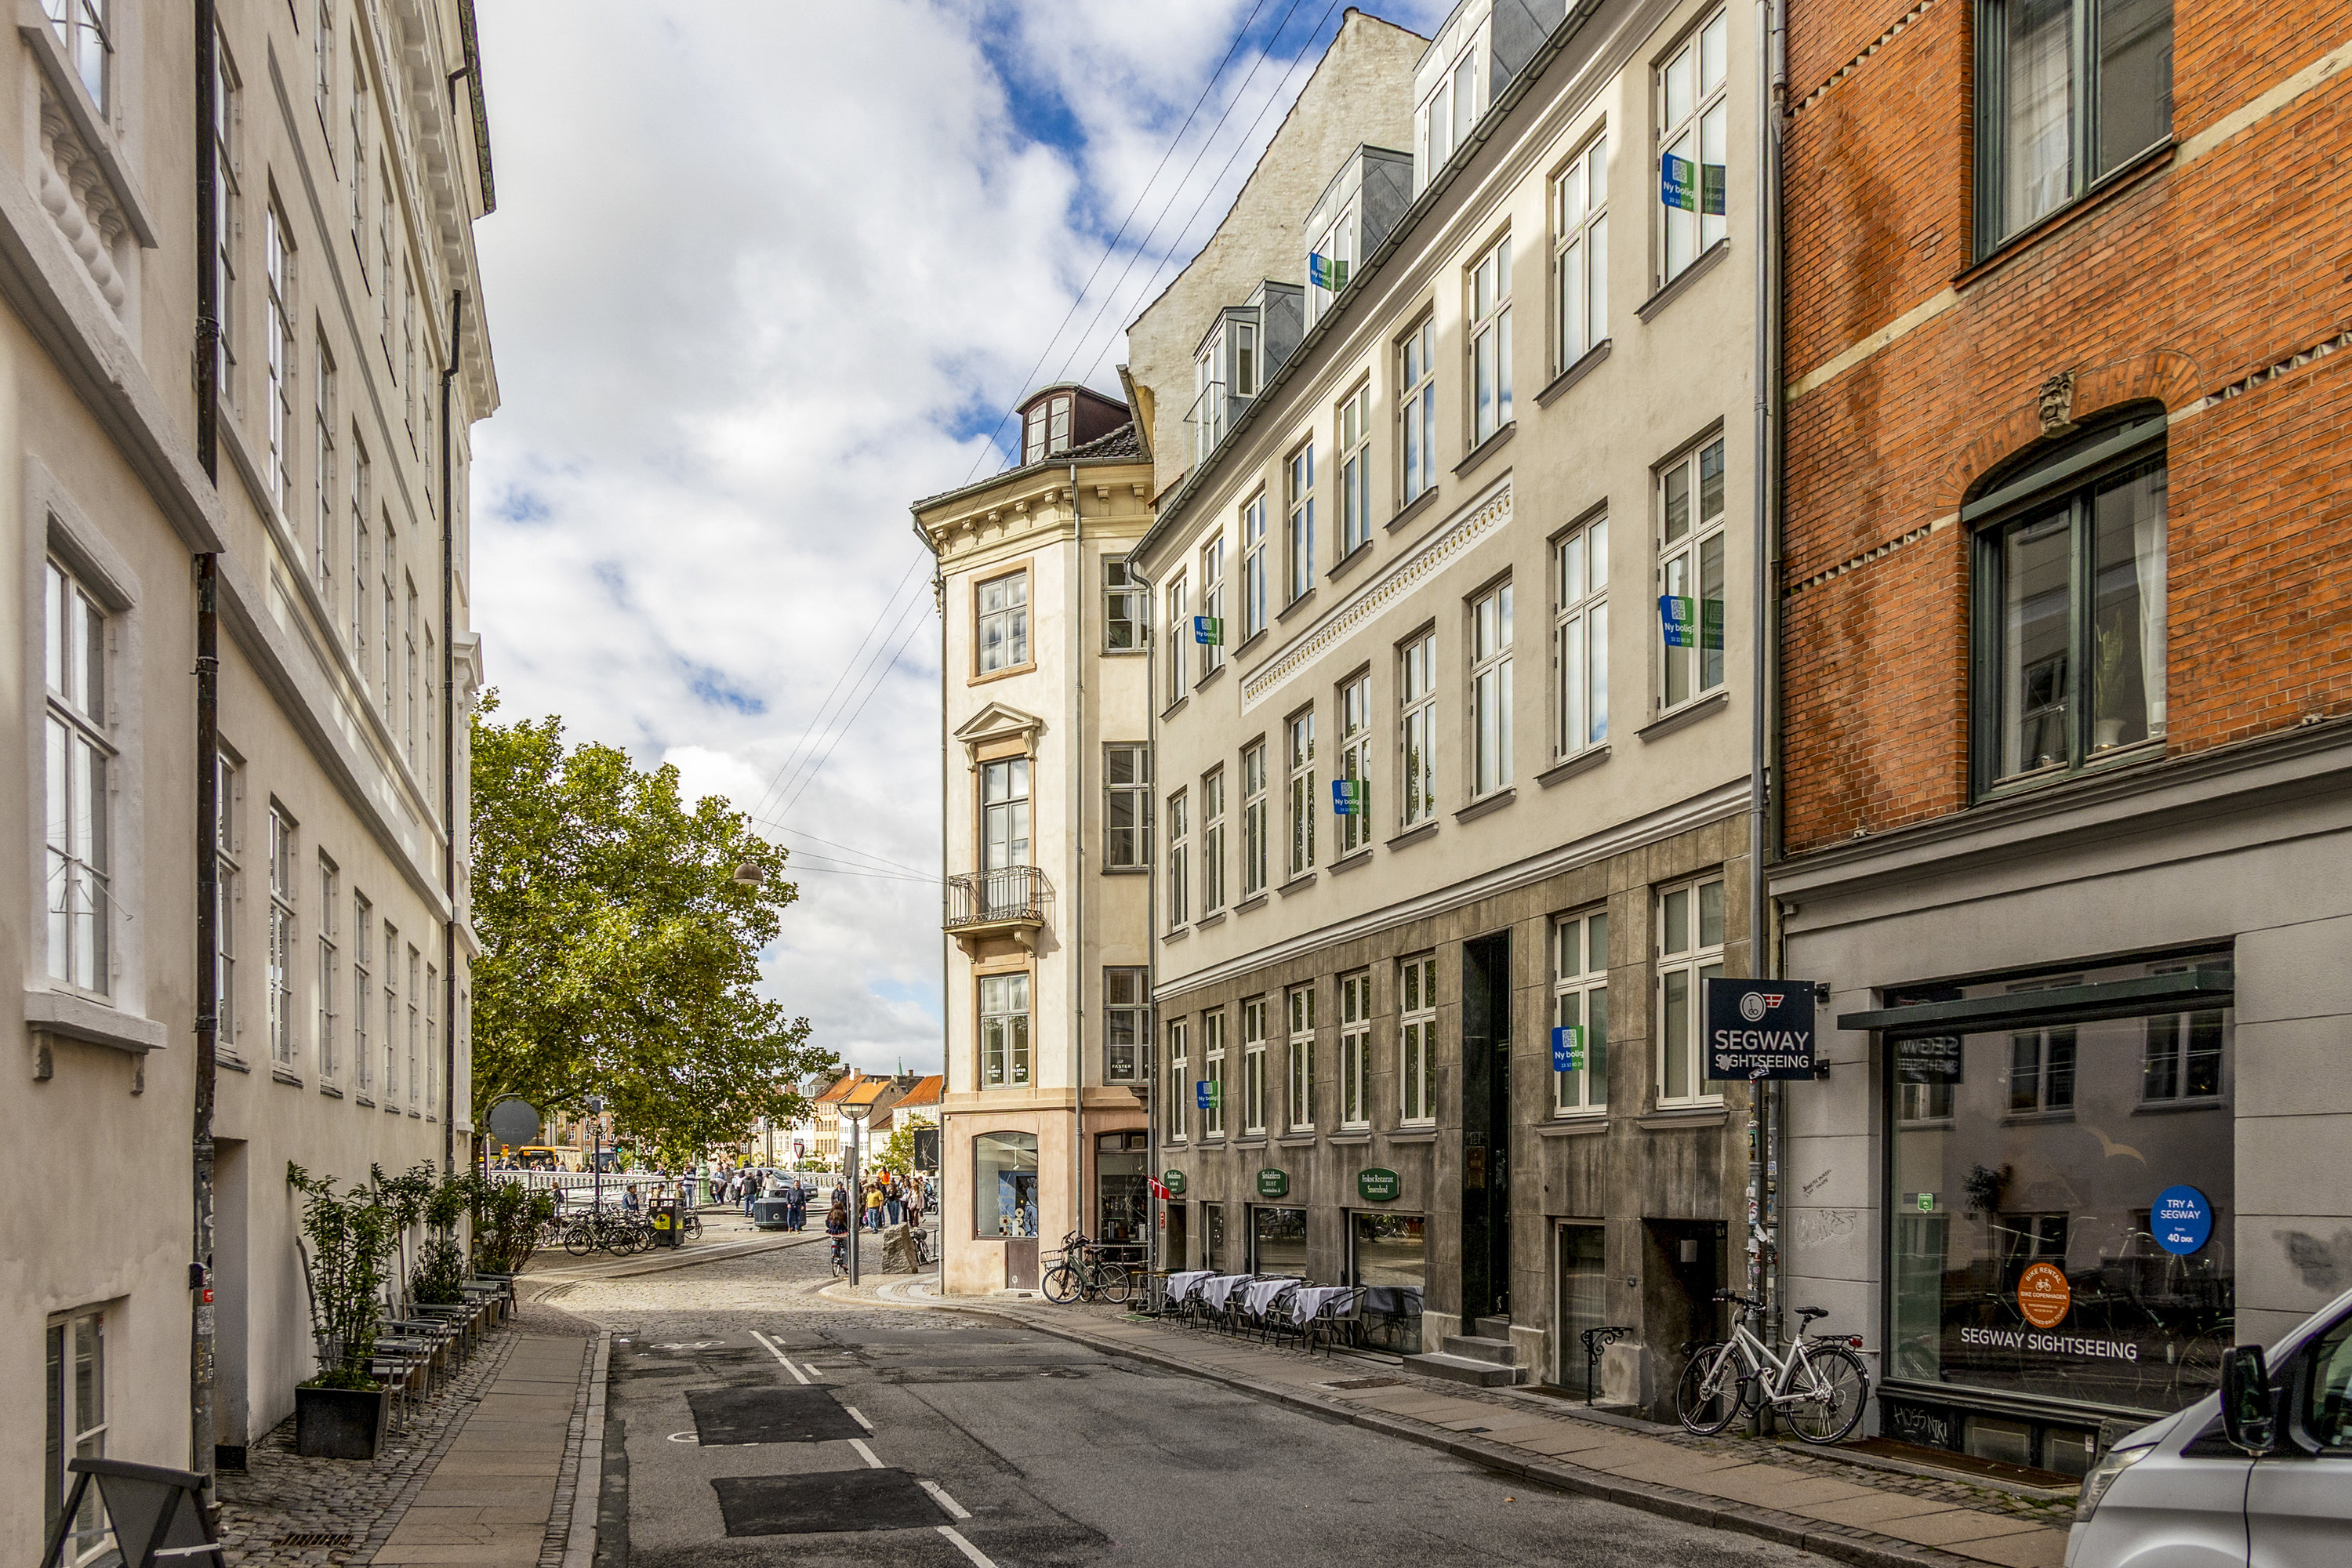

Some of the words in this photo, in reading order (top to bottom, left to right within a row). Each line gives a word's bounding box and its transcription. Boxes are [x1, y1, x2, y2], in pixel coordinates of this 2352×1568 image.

[1663, 181, 1674, 193] Ny
[1664, 622, 1674, 633] Ny
[1715, 1029, 1809, 1051] SEGWAY
[1555, 1051, 1564, 1060] Ny
[2166, 1200, 2185, 1208] TRY
[2187, 1200, 2194, 1208] A
[2160, 1210, 2201, 1219] SEGWAY
[2167, 1233, 2180, 1243] 40
[2025, 1268, 2039, 1282] BIKE
[2039, 1267, 2062, 1284] RENTAL
[2053, 1306, 2066, 1321] TOURS
[1961, 1327, 2024, 1348] SEGWAY
[2027, 1334, 2138, 1360] SIGHTSEEING
